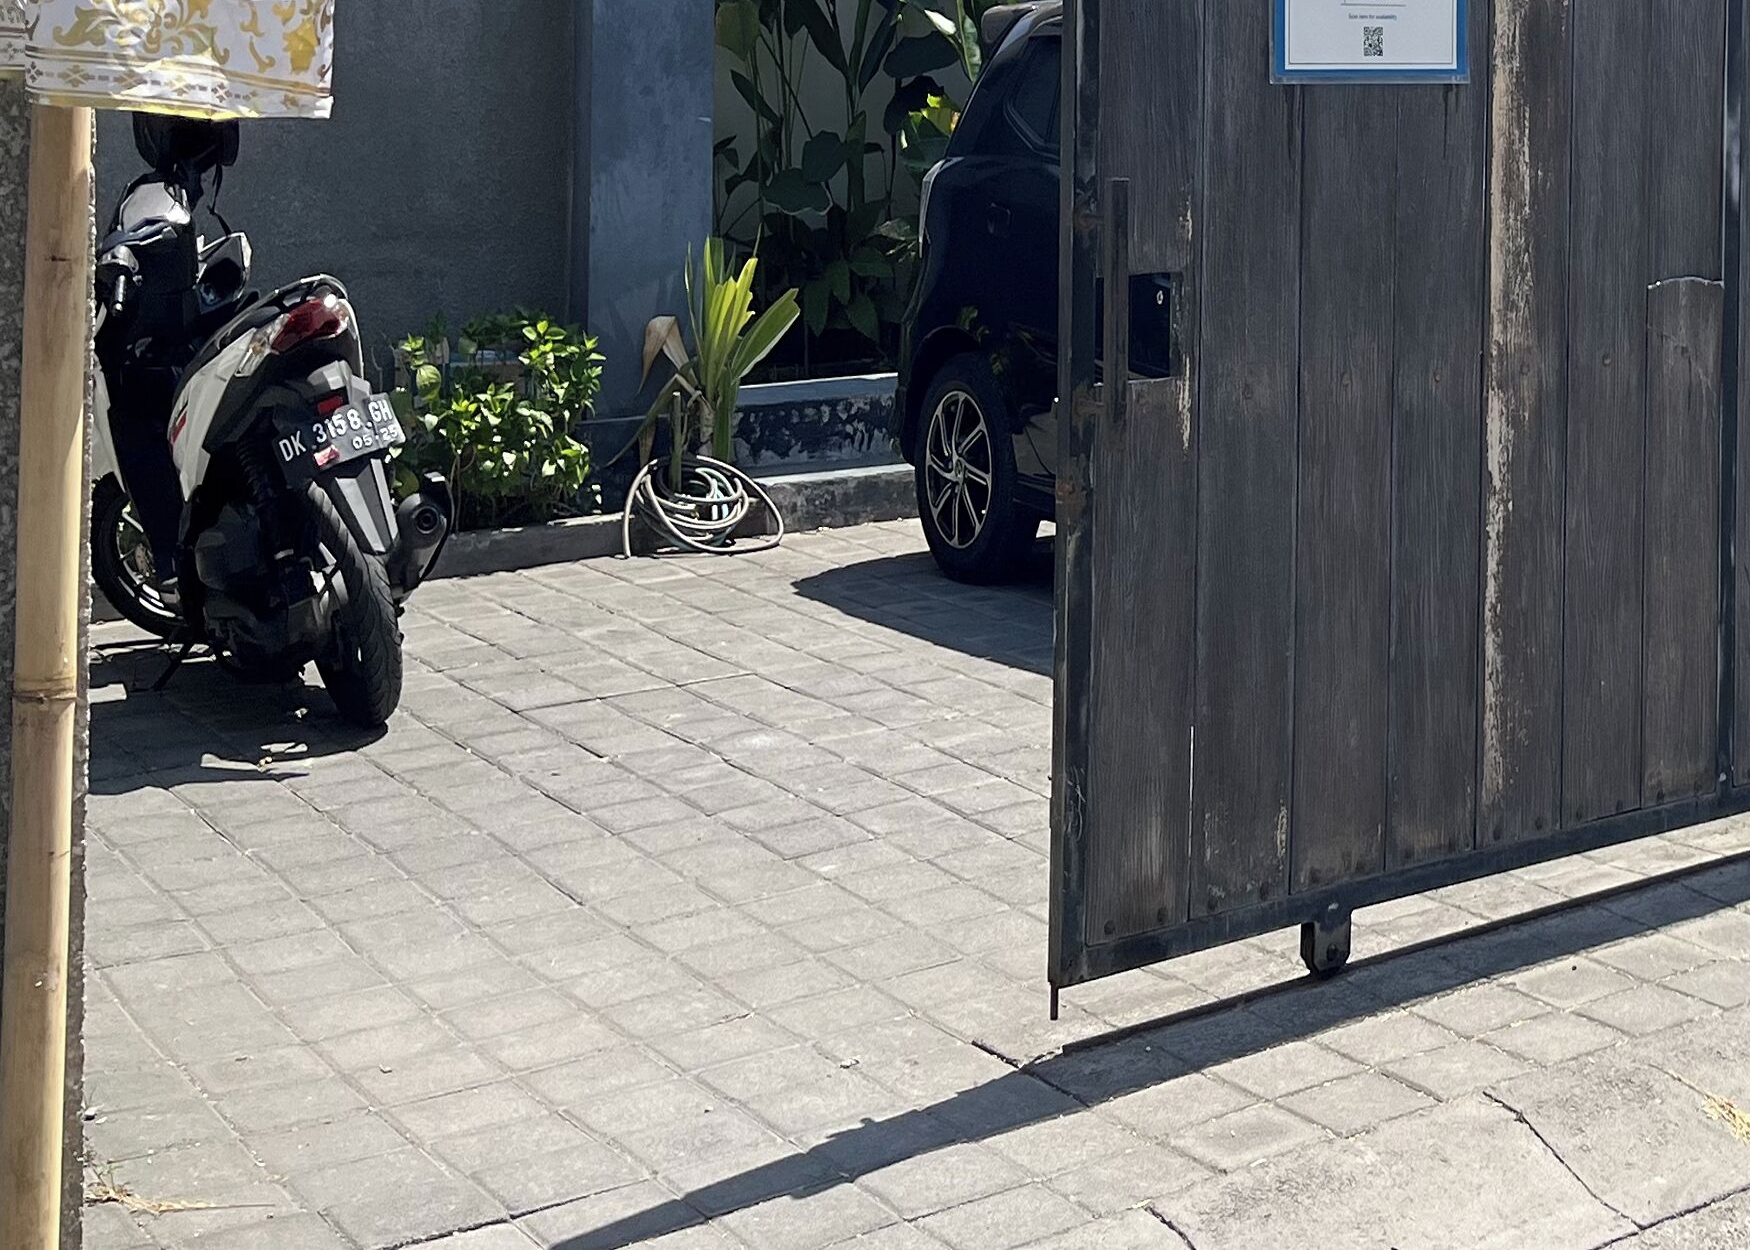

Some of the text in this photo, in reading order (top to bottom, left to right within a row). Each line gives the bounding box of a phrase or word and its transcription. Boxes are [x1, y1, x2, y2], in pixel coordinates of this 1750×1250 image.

[279, 399, 393, 462] DK 3158 GH
